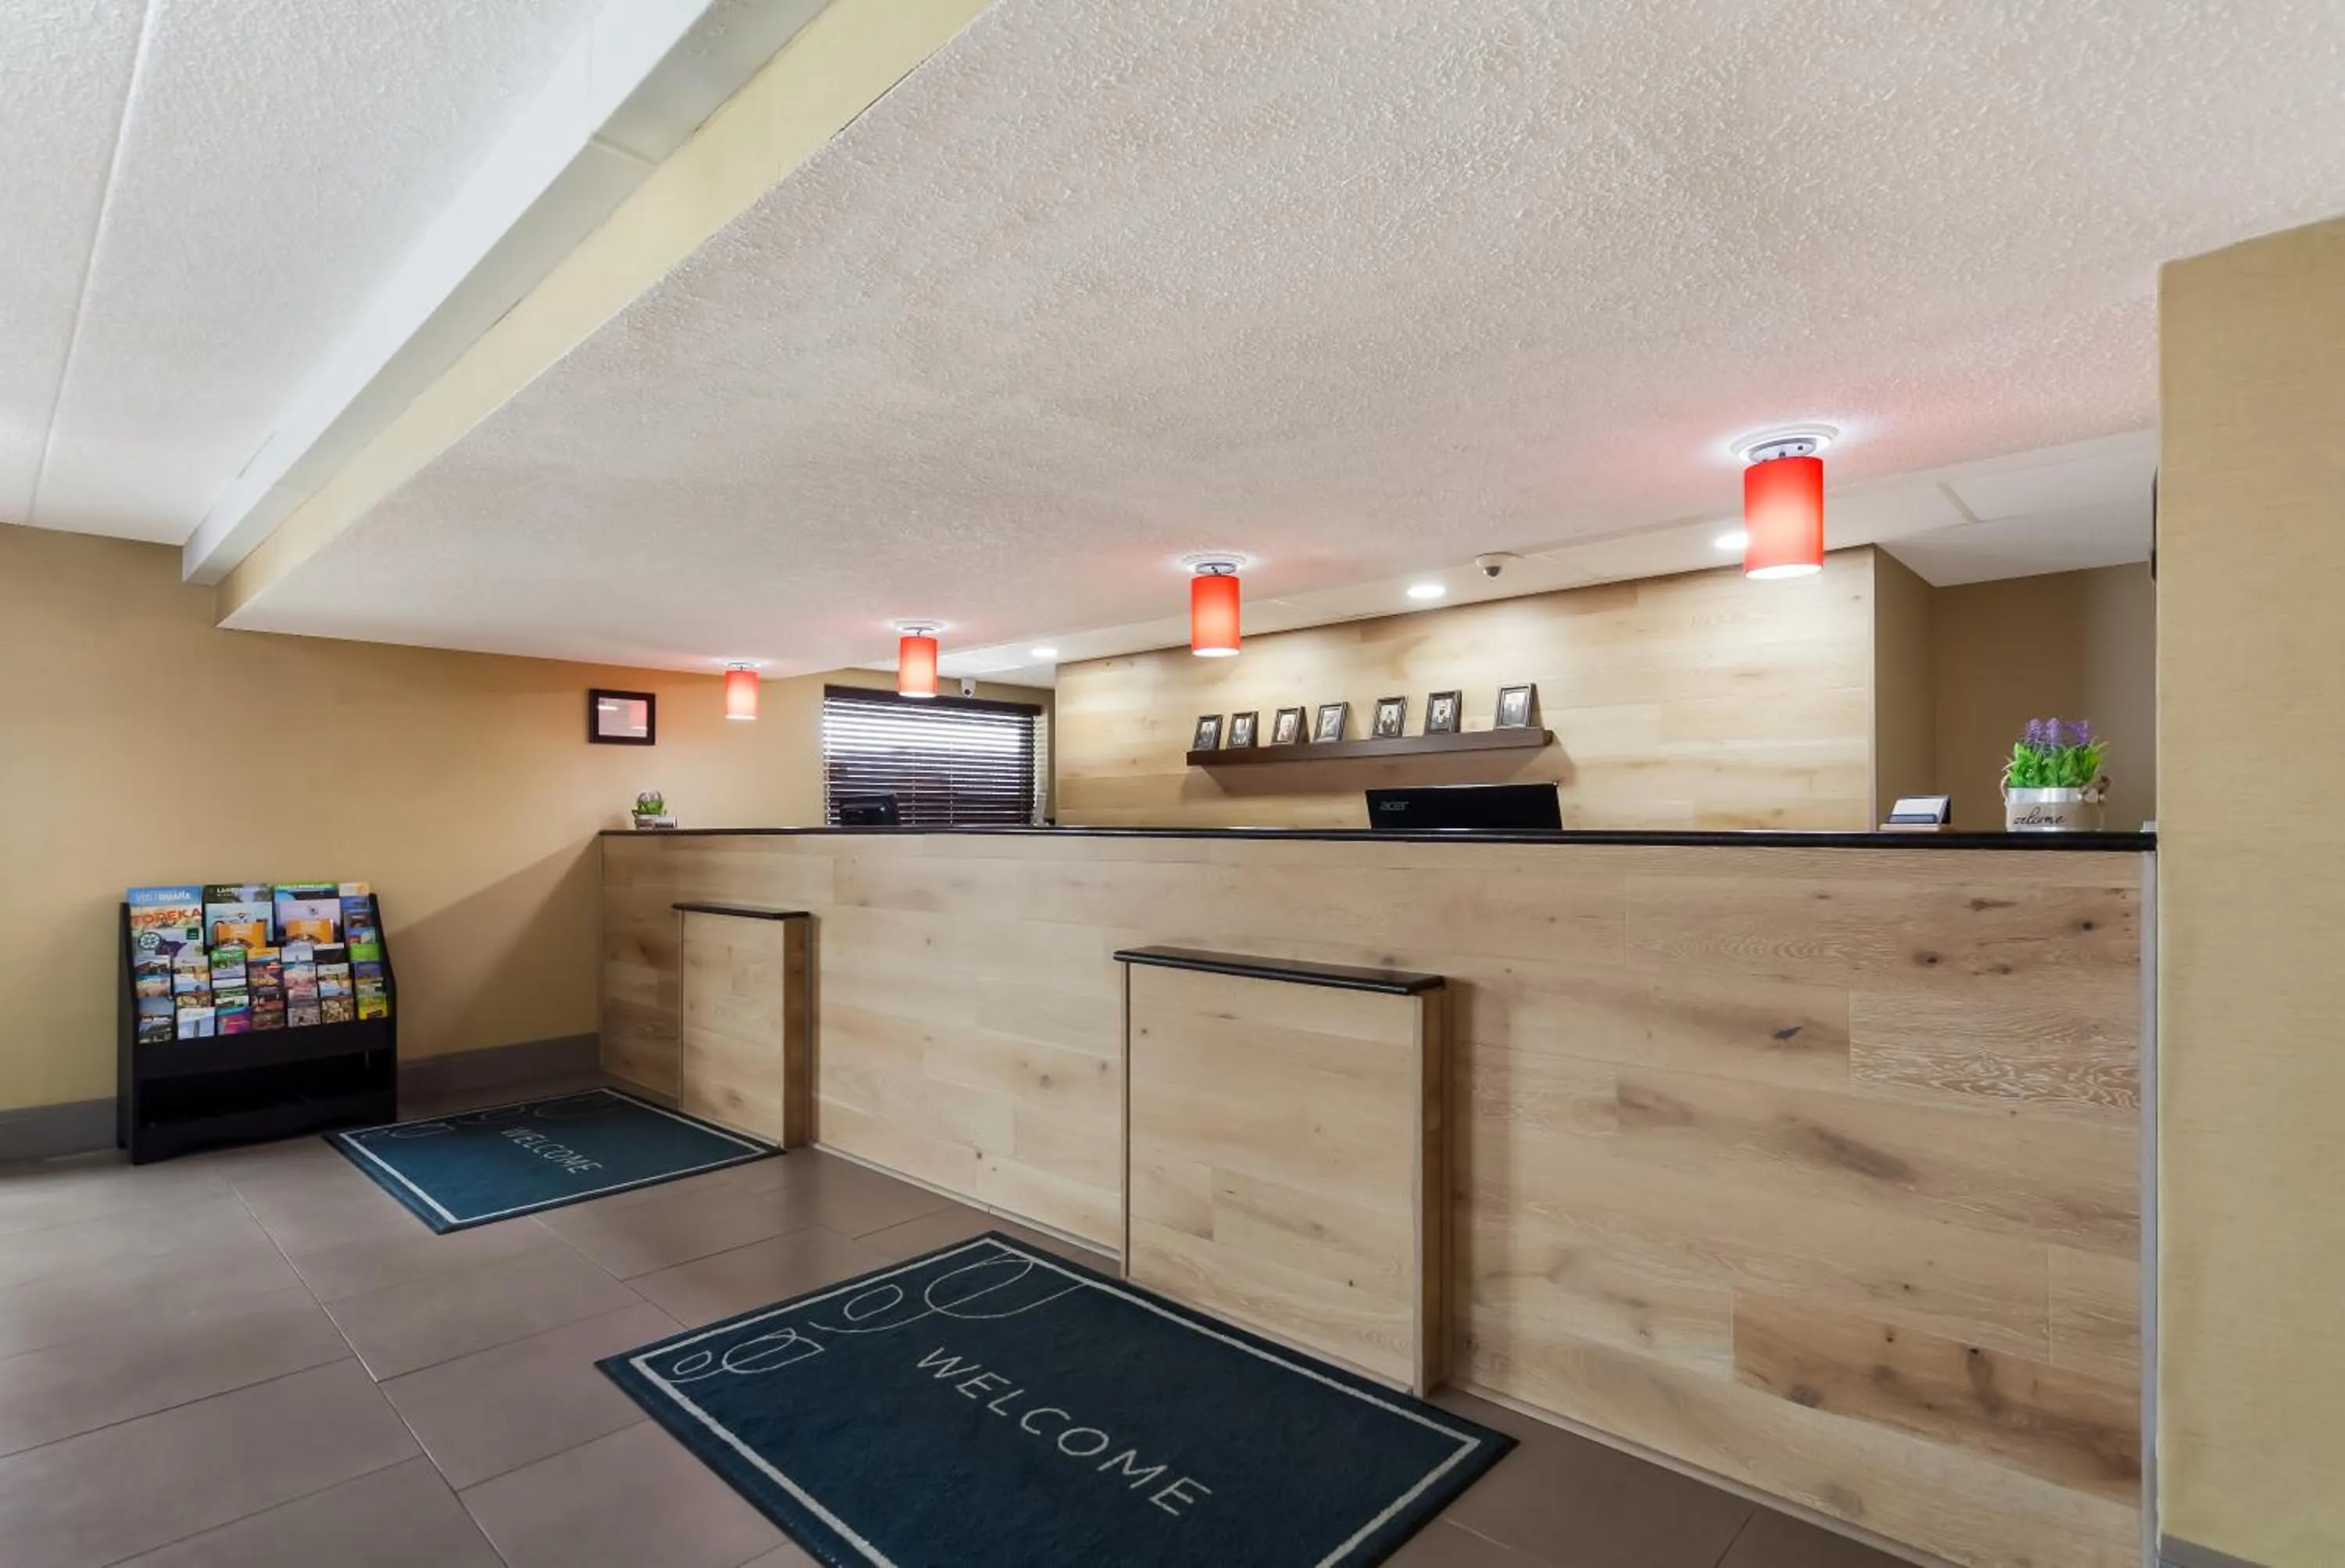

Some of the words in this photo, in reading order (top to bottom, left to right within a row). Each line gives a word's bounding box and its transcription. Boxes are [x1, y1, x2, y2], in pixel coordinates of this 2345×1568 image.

[1379, 800, 1410, 811] acer
[501, 1126, 603, 1173] WELCOME
[916, 1347, 1212, 1516] WELCOME
